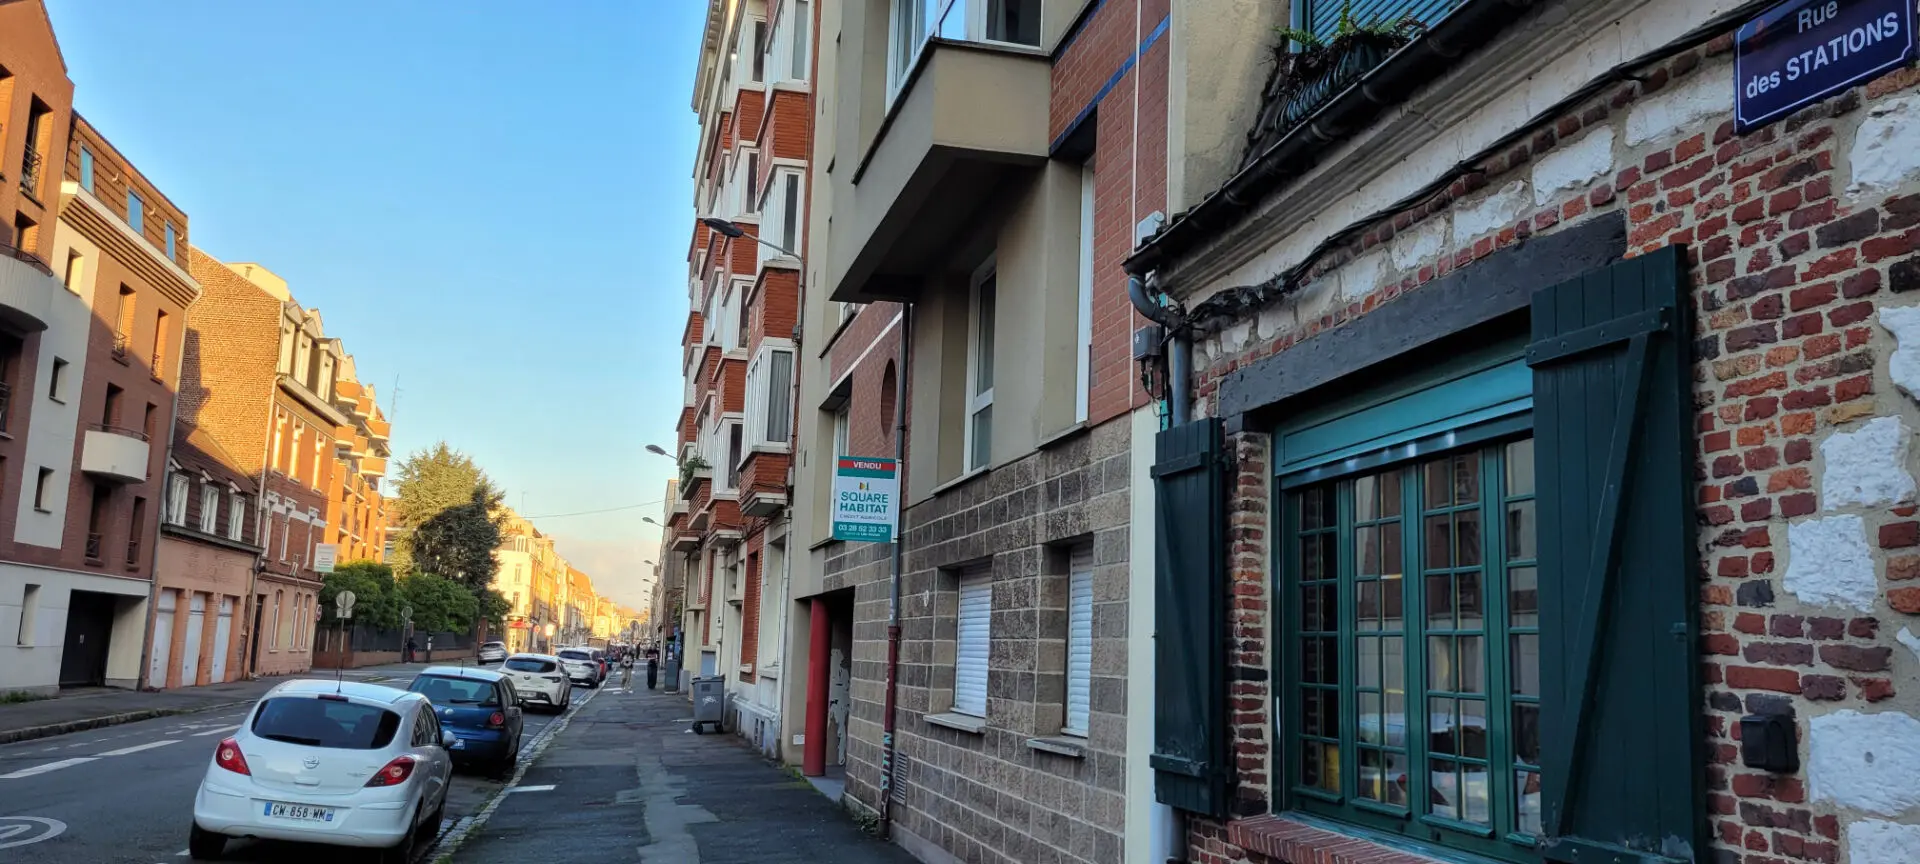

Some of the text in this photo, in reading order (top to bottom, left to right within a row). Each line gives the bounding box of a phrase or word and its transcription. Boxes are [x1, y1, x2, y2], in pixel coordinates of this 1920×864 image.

[1798, 0, 1838, 33] Rue
[1746, 12, 1899, 98] des STATIONS
[853, 461, 882, 470] VENDU
[840, 491, 889, 504] SQUARE
[840, 502, 888, 514] HABITAT
[838, 524, 848, 532] 03
